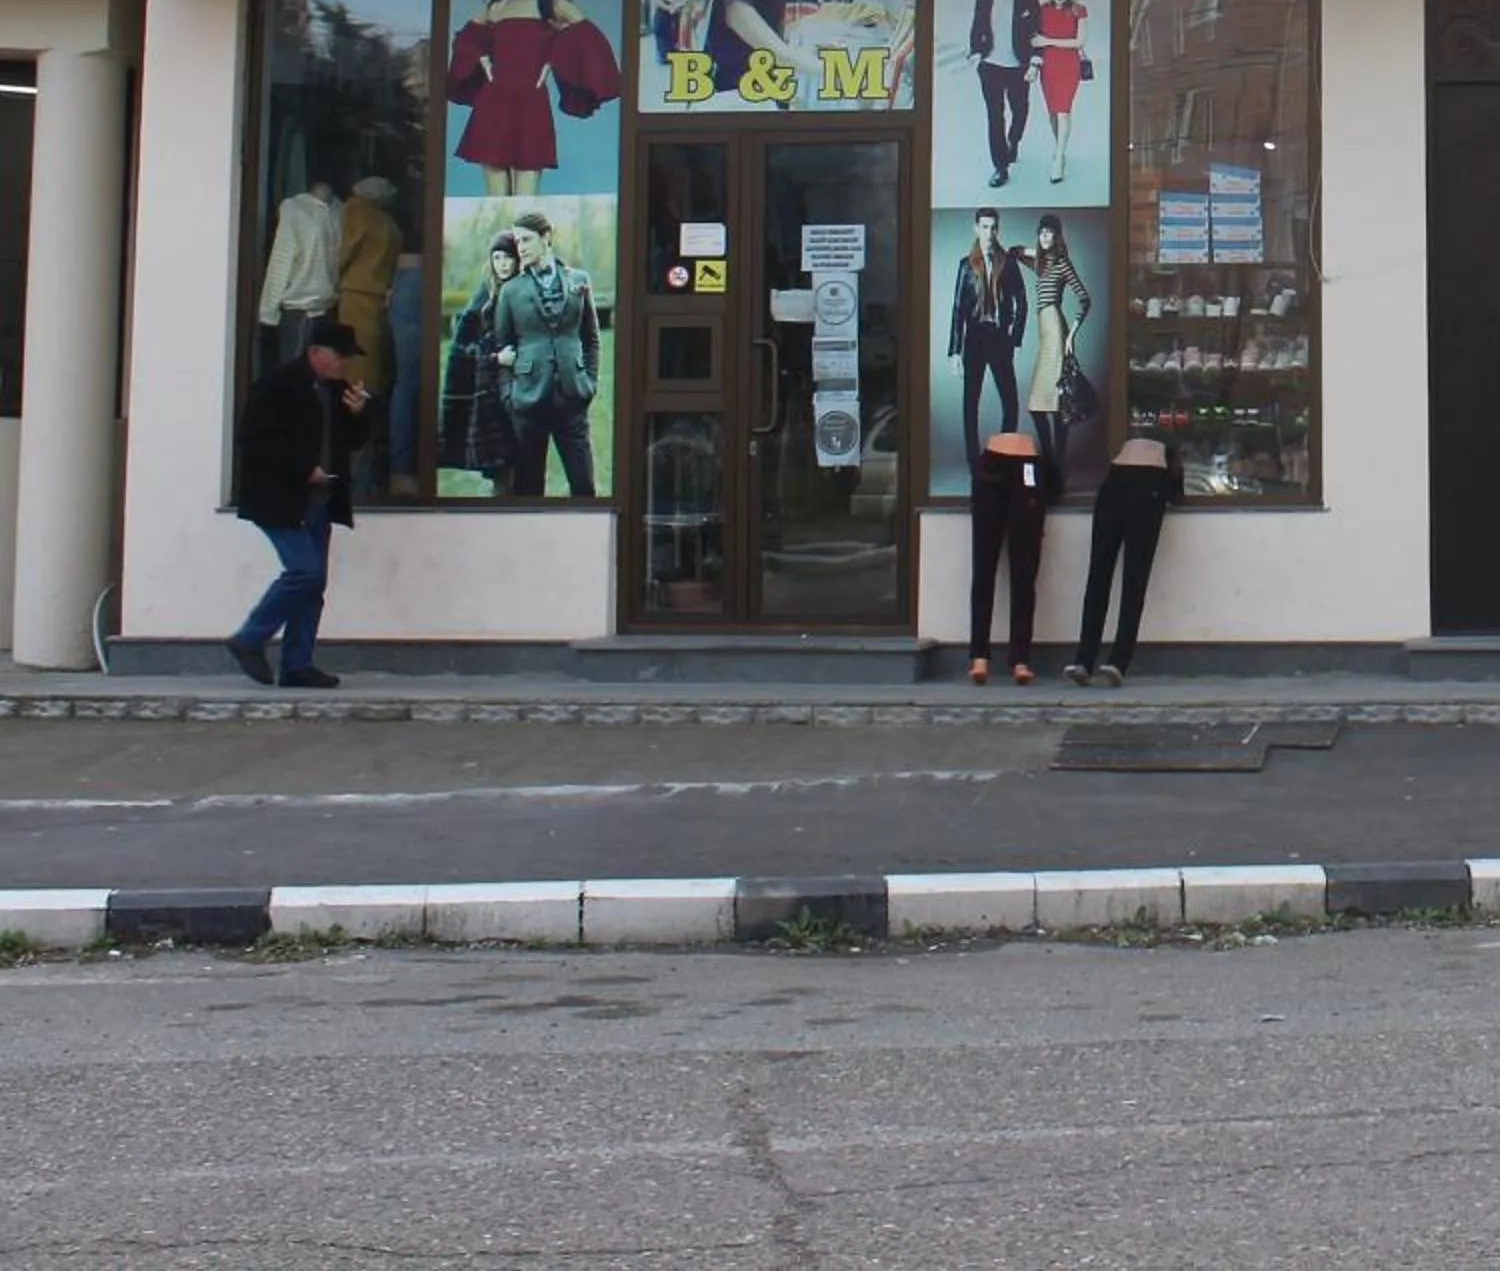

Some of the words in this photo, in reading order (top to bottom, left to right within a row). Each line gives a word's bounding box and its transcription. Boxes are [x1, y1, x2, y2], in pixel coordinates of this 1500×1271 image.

[664, 51, 715, 102] B
[739, 48, 797, 103] &
[818, 47, 890, 99] M
